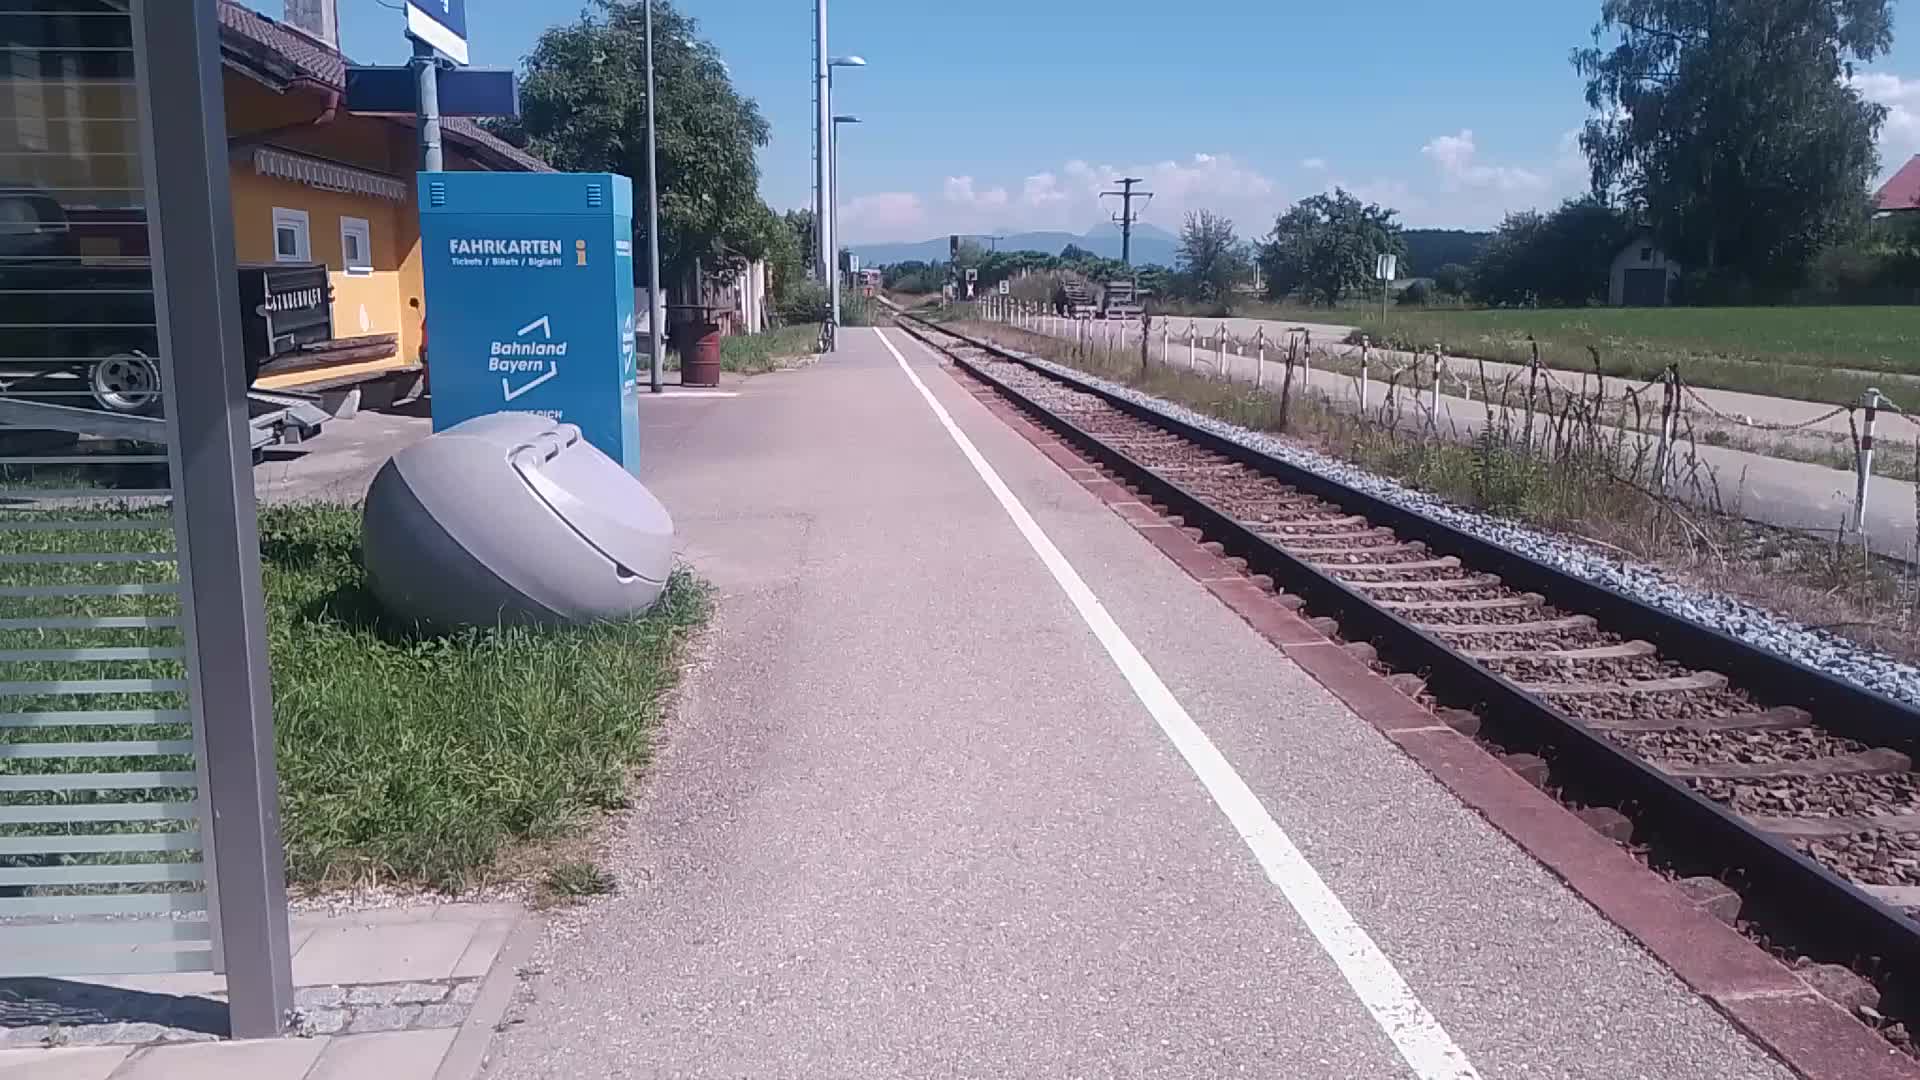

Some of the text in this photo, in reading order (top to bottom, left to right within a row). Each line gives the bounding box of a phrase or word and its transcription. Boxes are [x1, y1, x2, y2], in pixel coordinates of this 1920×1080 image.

[449, 239, 562, 255] FAHRKARTEN
[451, 257, 482, 266] Tickets
[491, 257, 519, 266] Billets
[528, 257, 562, 268] Biglietti
[490, 341, 568, 356] Bahnland
[488, 356, 544, 374] Bayern
